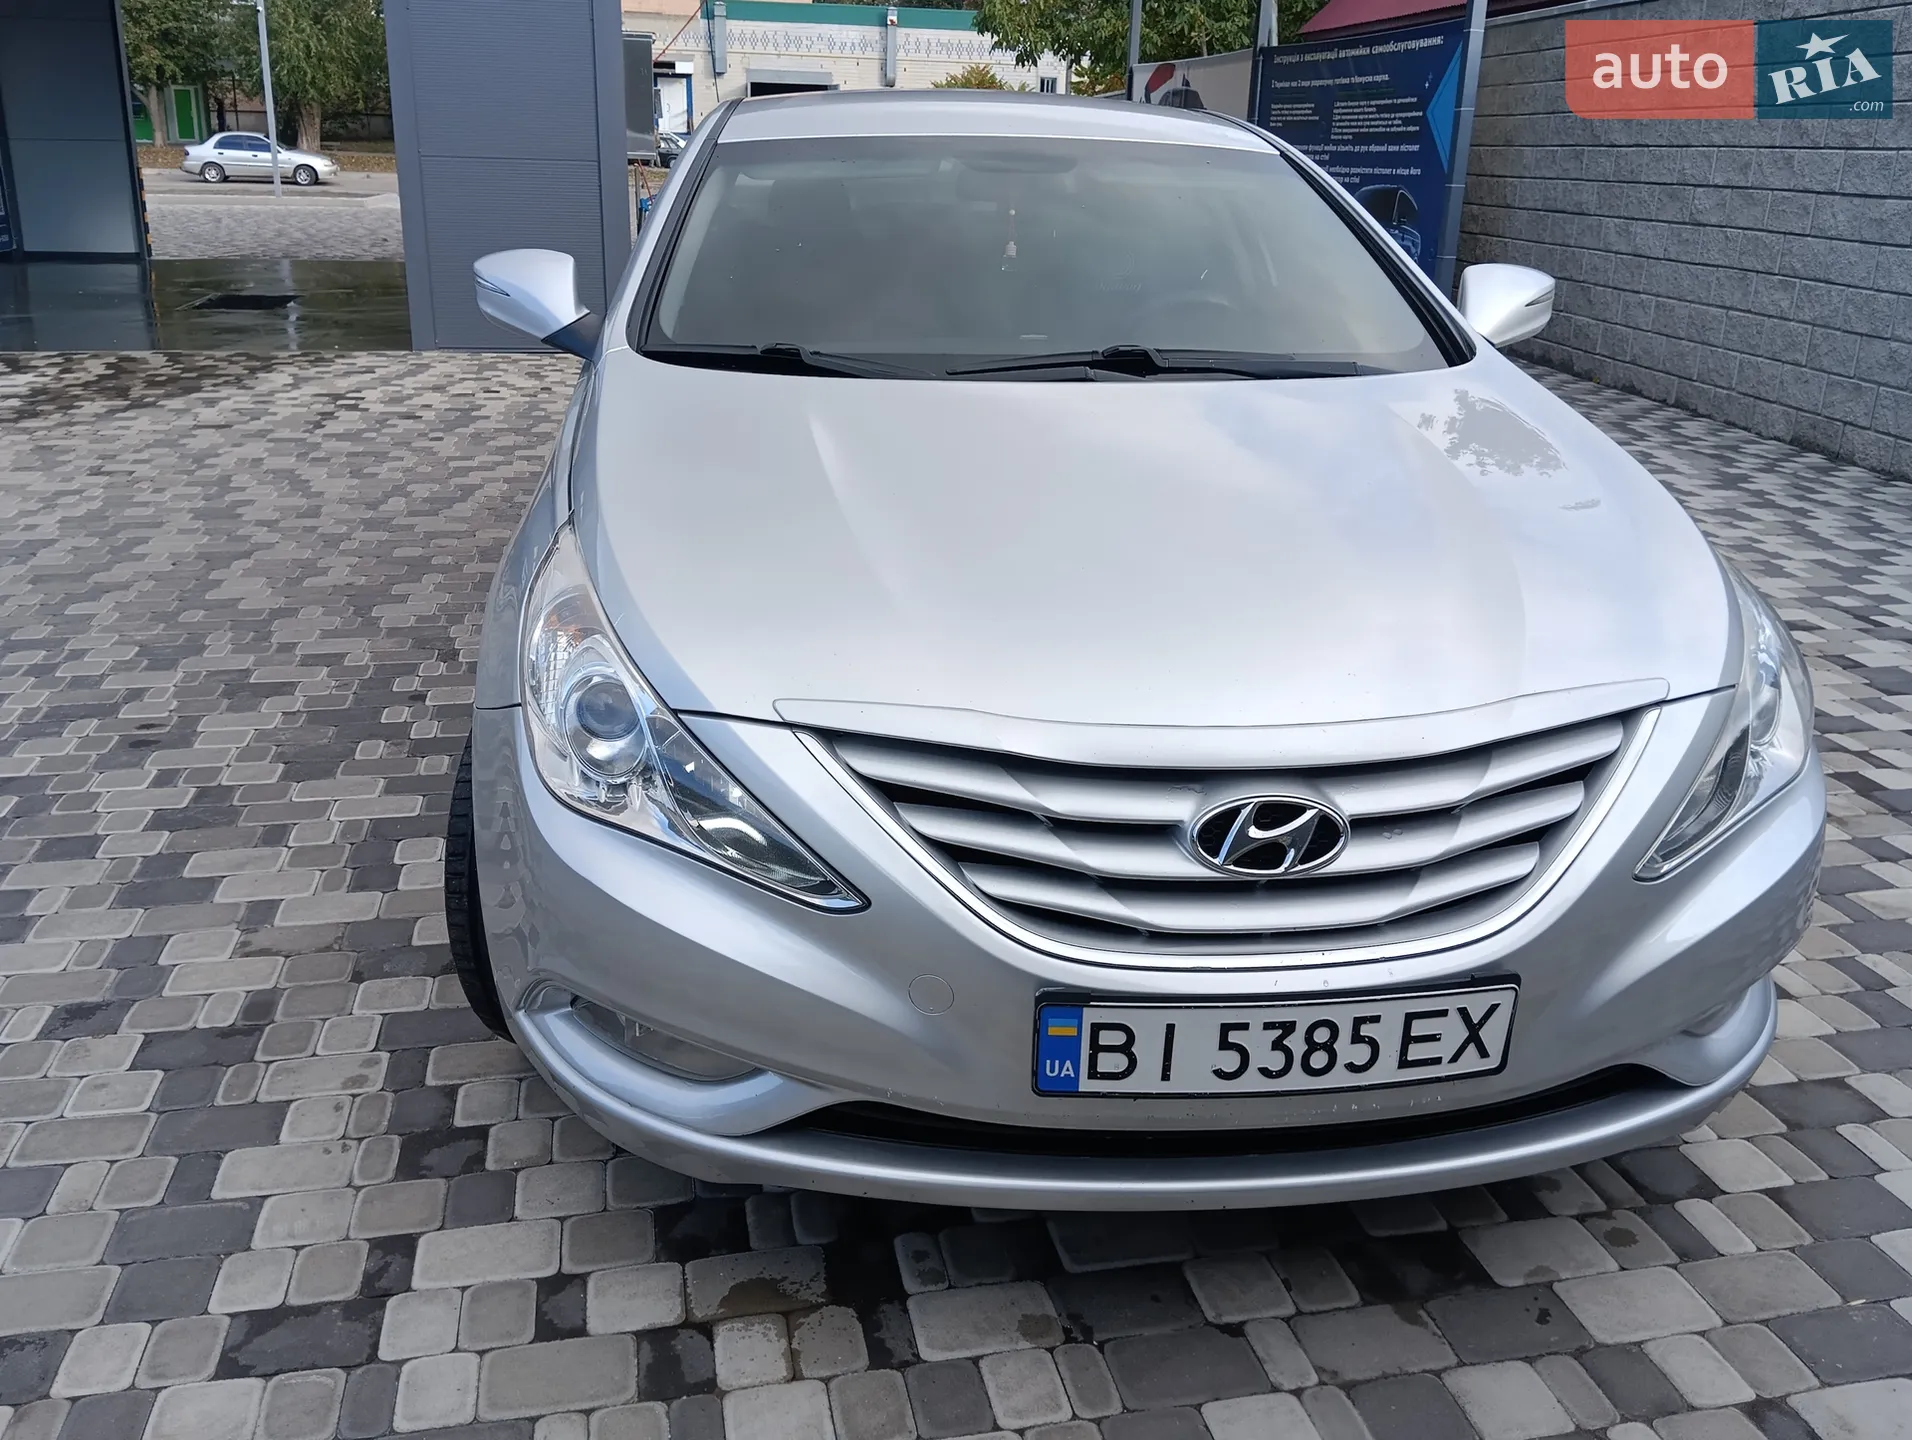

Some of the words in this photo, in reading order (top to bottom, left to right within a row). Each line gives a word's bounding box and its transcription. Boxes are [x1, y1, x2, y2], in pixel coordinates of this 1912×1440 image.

[1372, 35, 1444, 55] самообслуговування:
[1086, 1021, 1176, 1082] BI
[1211, 1013, 1382, 1078] 5385
[1397, 1001, 1501, 1070] EX
[1045, 1060, 1075, 1078] UA
